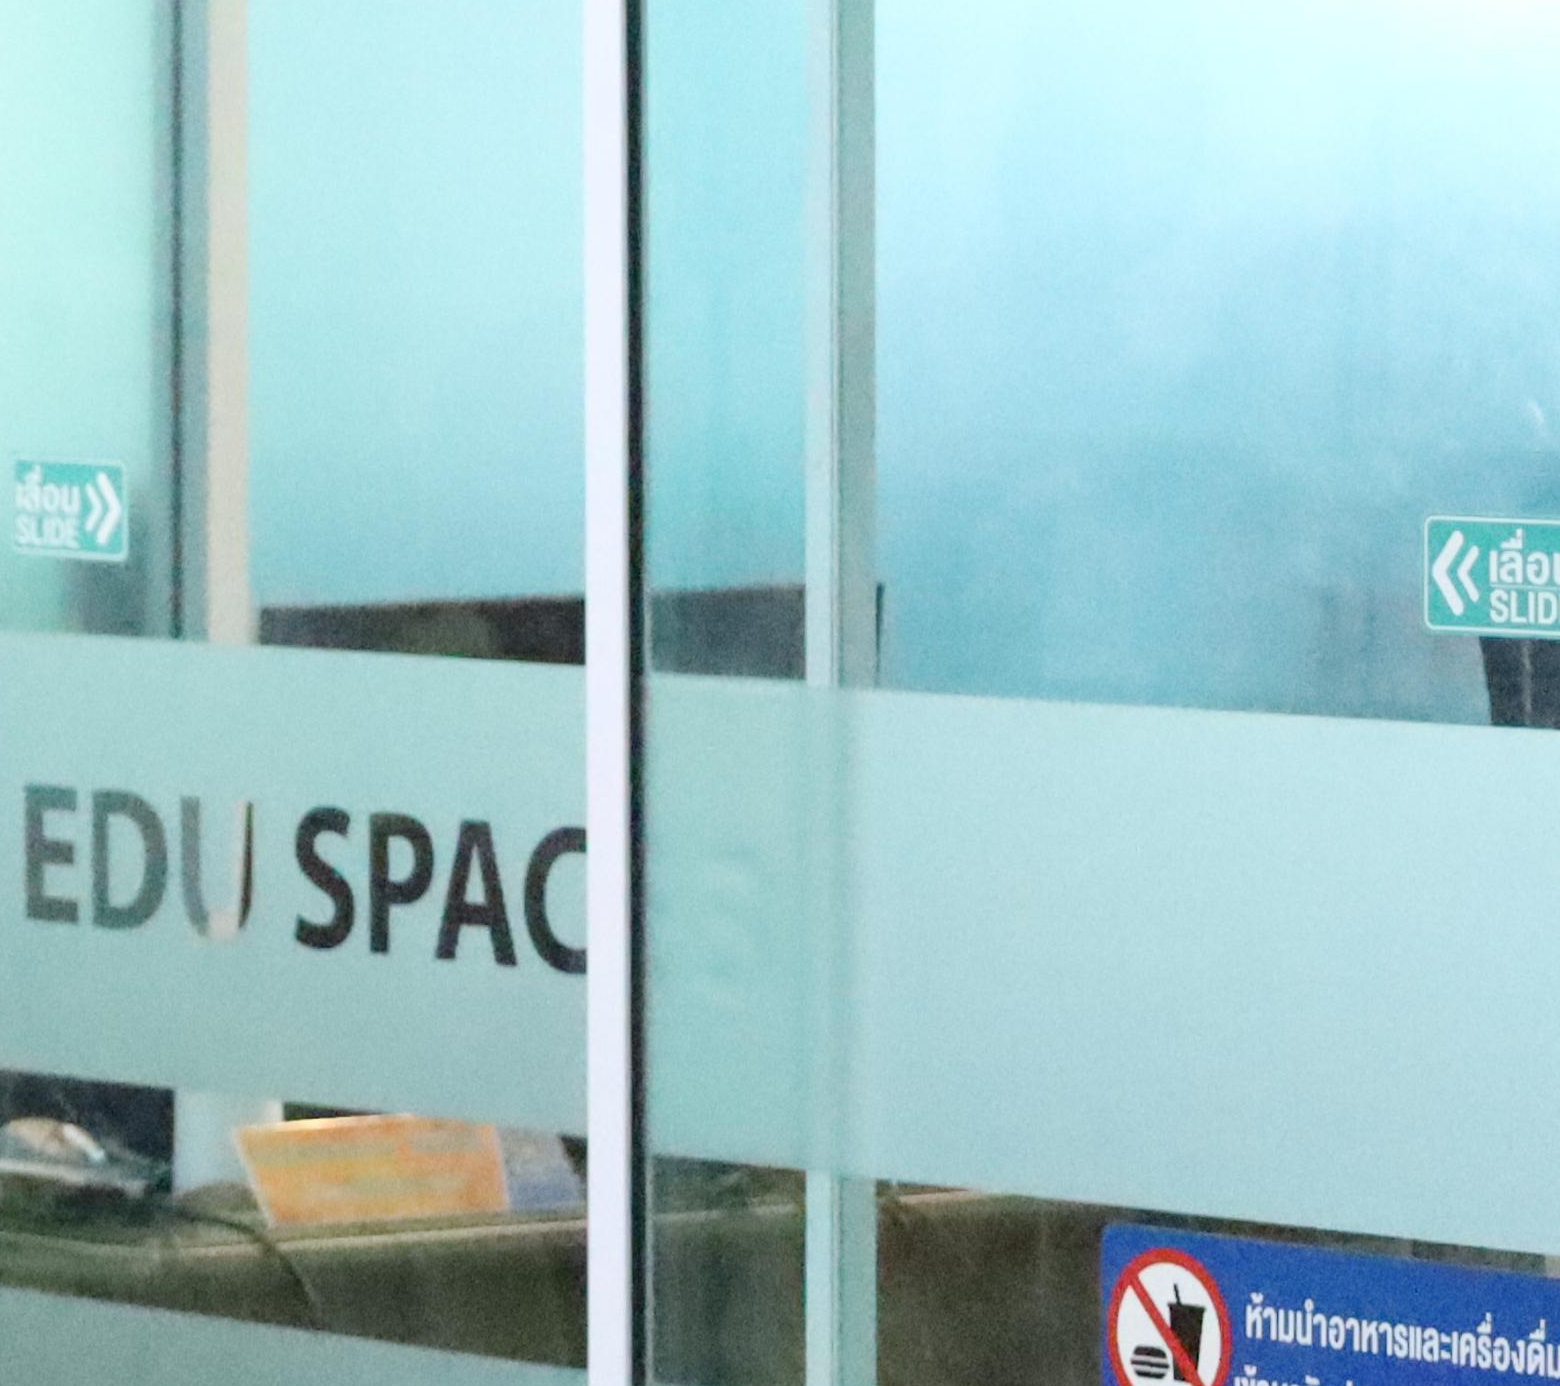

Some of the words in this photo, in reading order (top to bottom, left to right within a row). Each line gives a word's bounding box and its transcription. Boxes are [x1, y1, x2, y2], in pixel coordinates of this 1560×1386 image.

[14, 465, 80, 513] เลื่อน
[14, 513, 81, 550] SLIDE
[23, 784, 254, 942] EDU
[294, 805, 588, 975] SPAC
